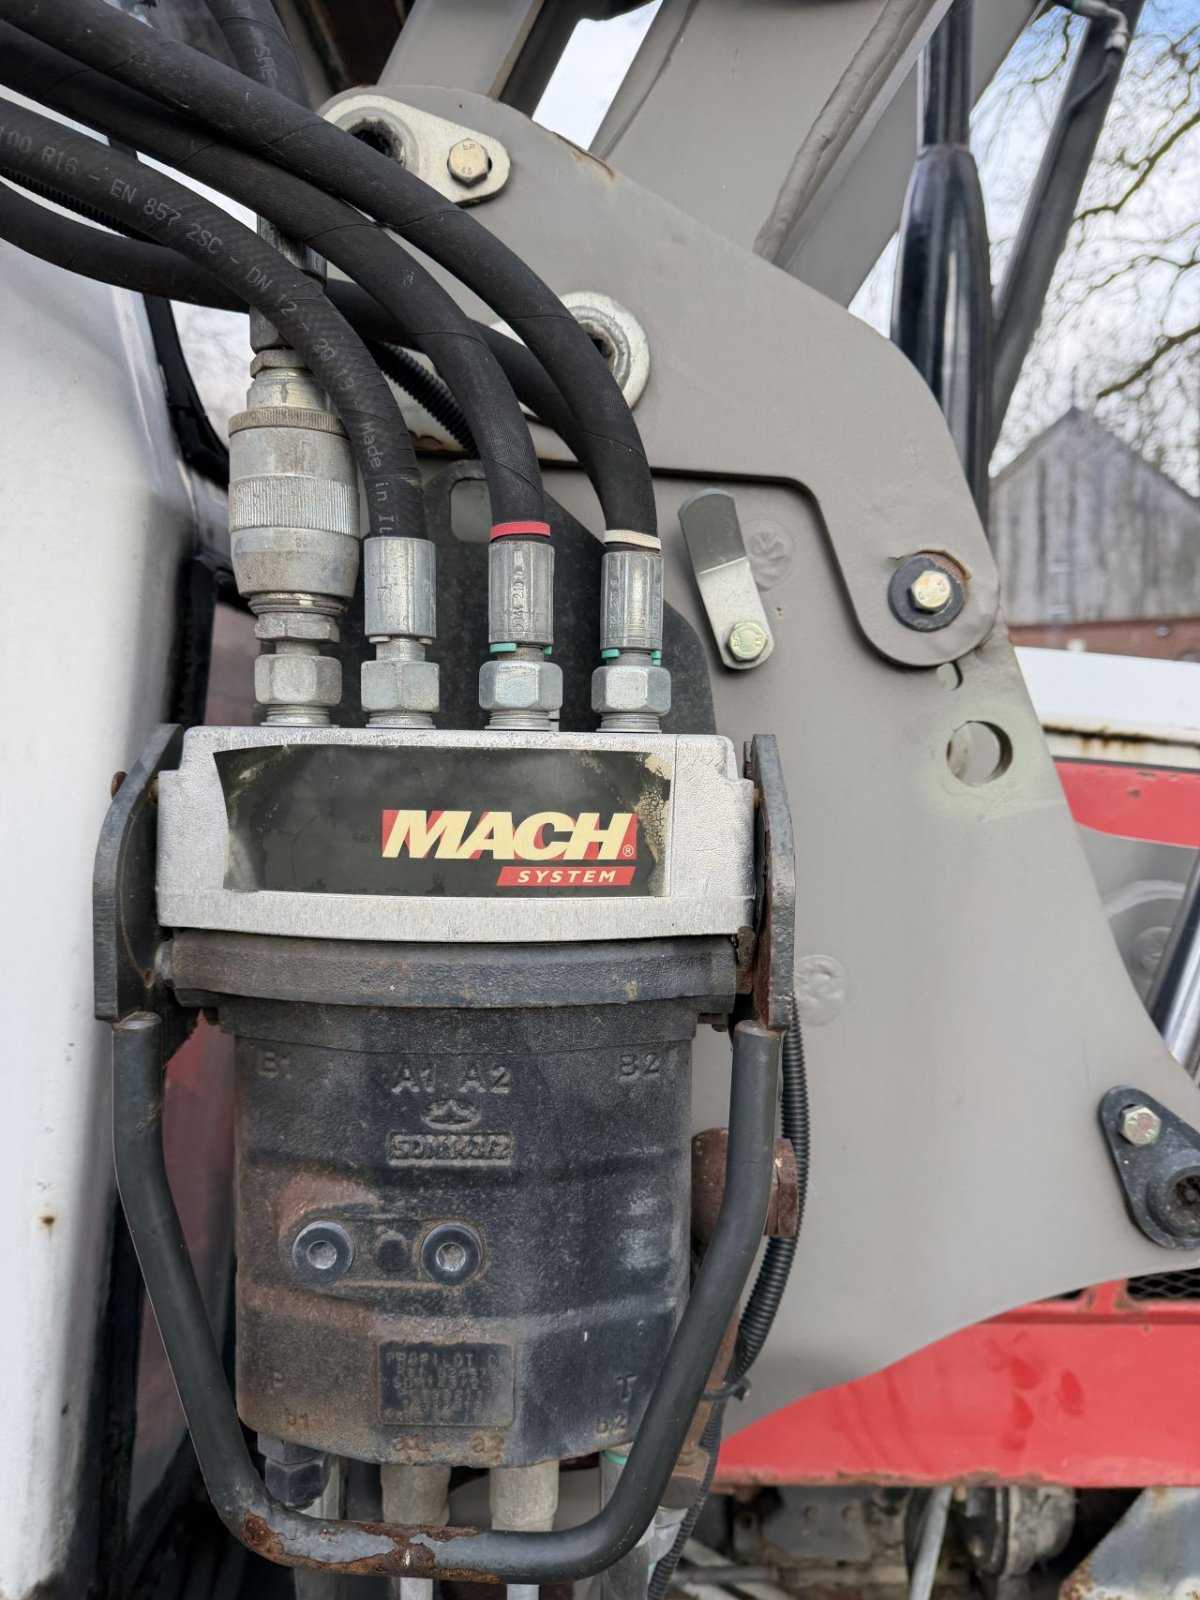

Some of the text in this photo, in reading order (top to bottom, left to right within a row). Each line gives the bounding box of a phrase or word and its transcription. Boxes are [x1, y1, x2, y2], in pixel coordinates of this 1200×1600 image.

[41, 145, 79, 175] R16
[109, 178, 137, 204] EN
[143, 197, 182, 226] 857
[186, 223, 222, 254] 2SC
[244, 266, 273, 292] DN
[275, 294, 297, 316] 12
[360, 420, 384, 469] Made
[375, 481, 390, 502] in
[378, 513, 395, 538] It
[382, 810, 633, 860] MACH
[517, 870, 616, 883] SYSTEM
[391, 1063, 512, 1095] A1 A2
[619, 1052, 661, 1082] B2
[617, 1375, 638, 1403] T
[596, 1412, 627, 1435] b2
